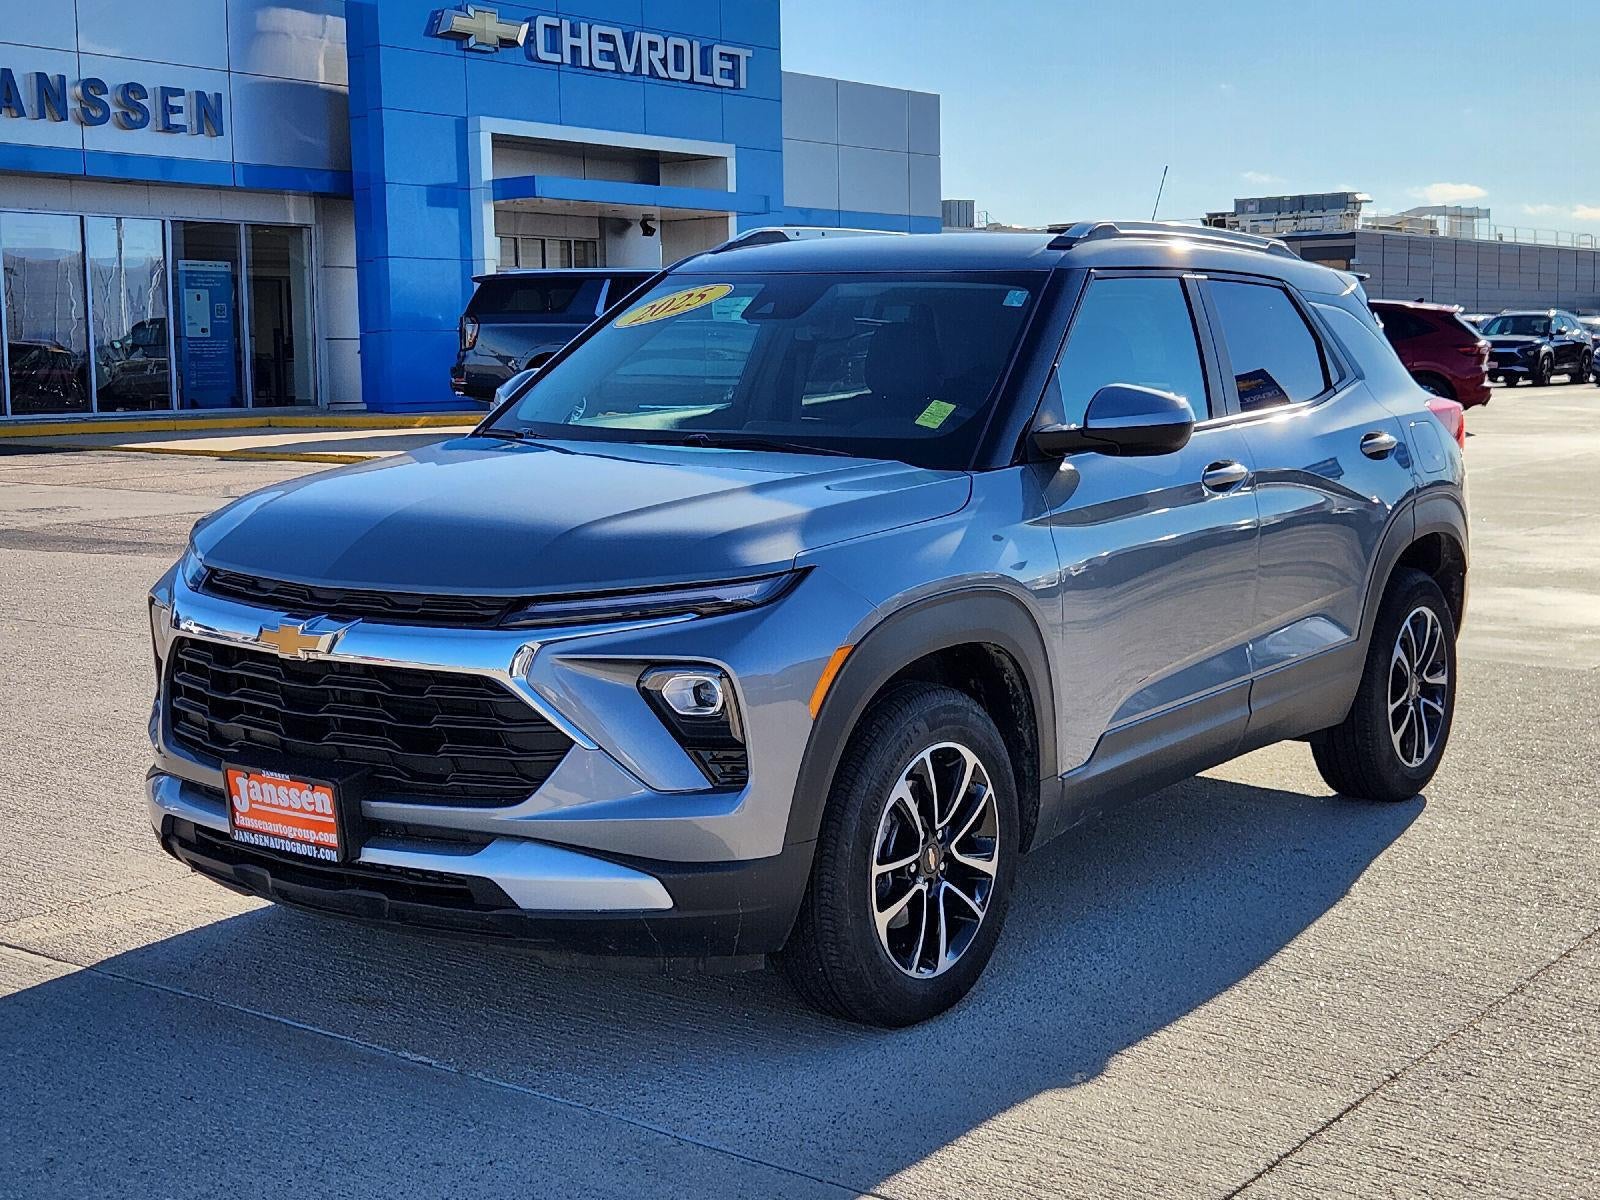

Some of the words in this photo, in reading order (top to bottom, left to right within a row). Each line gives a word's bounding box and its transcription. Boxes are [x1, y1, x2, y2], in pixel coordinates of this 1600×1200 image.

[533, 15, 753, 89] CHEVROLET
[628, 286, 716, 325] 2025
[232, 777, 332, 814] Janssen
[234, 811, 338, 844] Janssenautogroup.com
